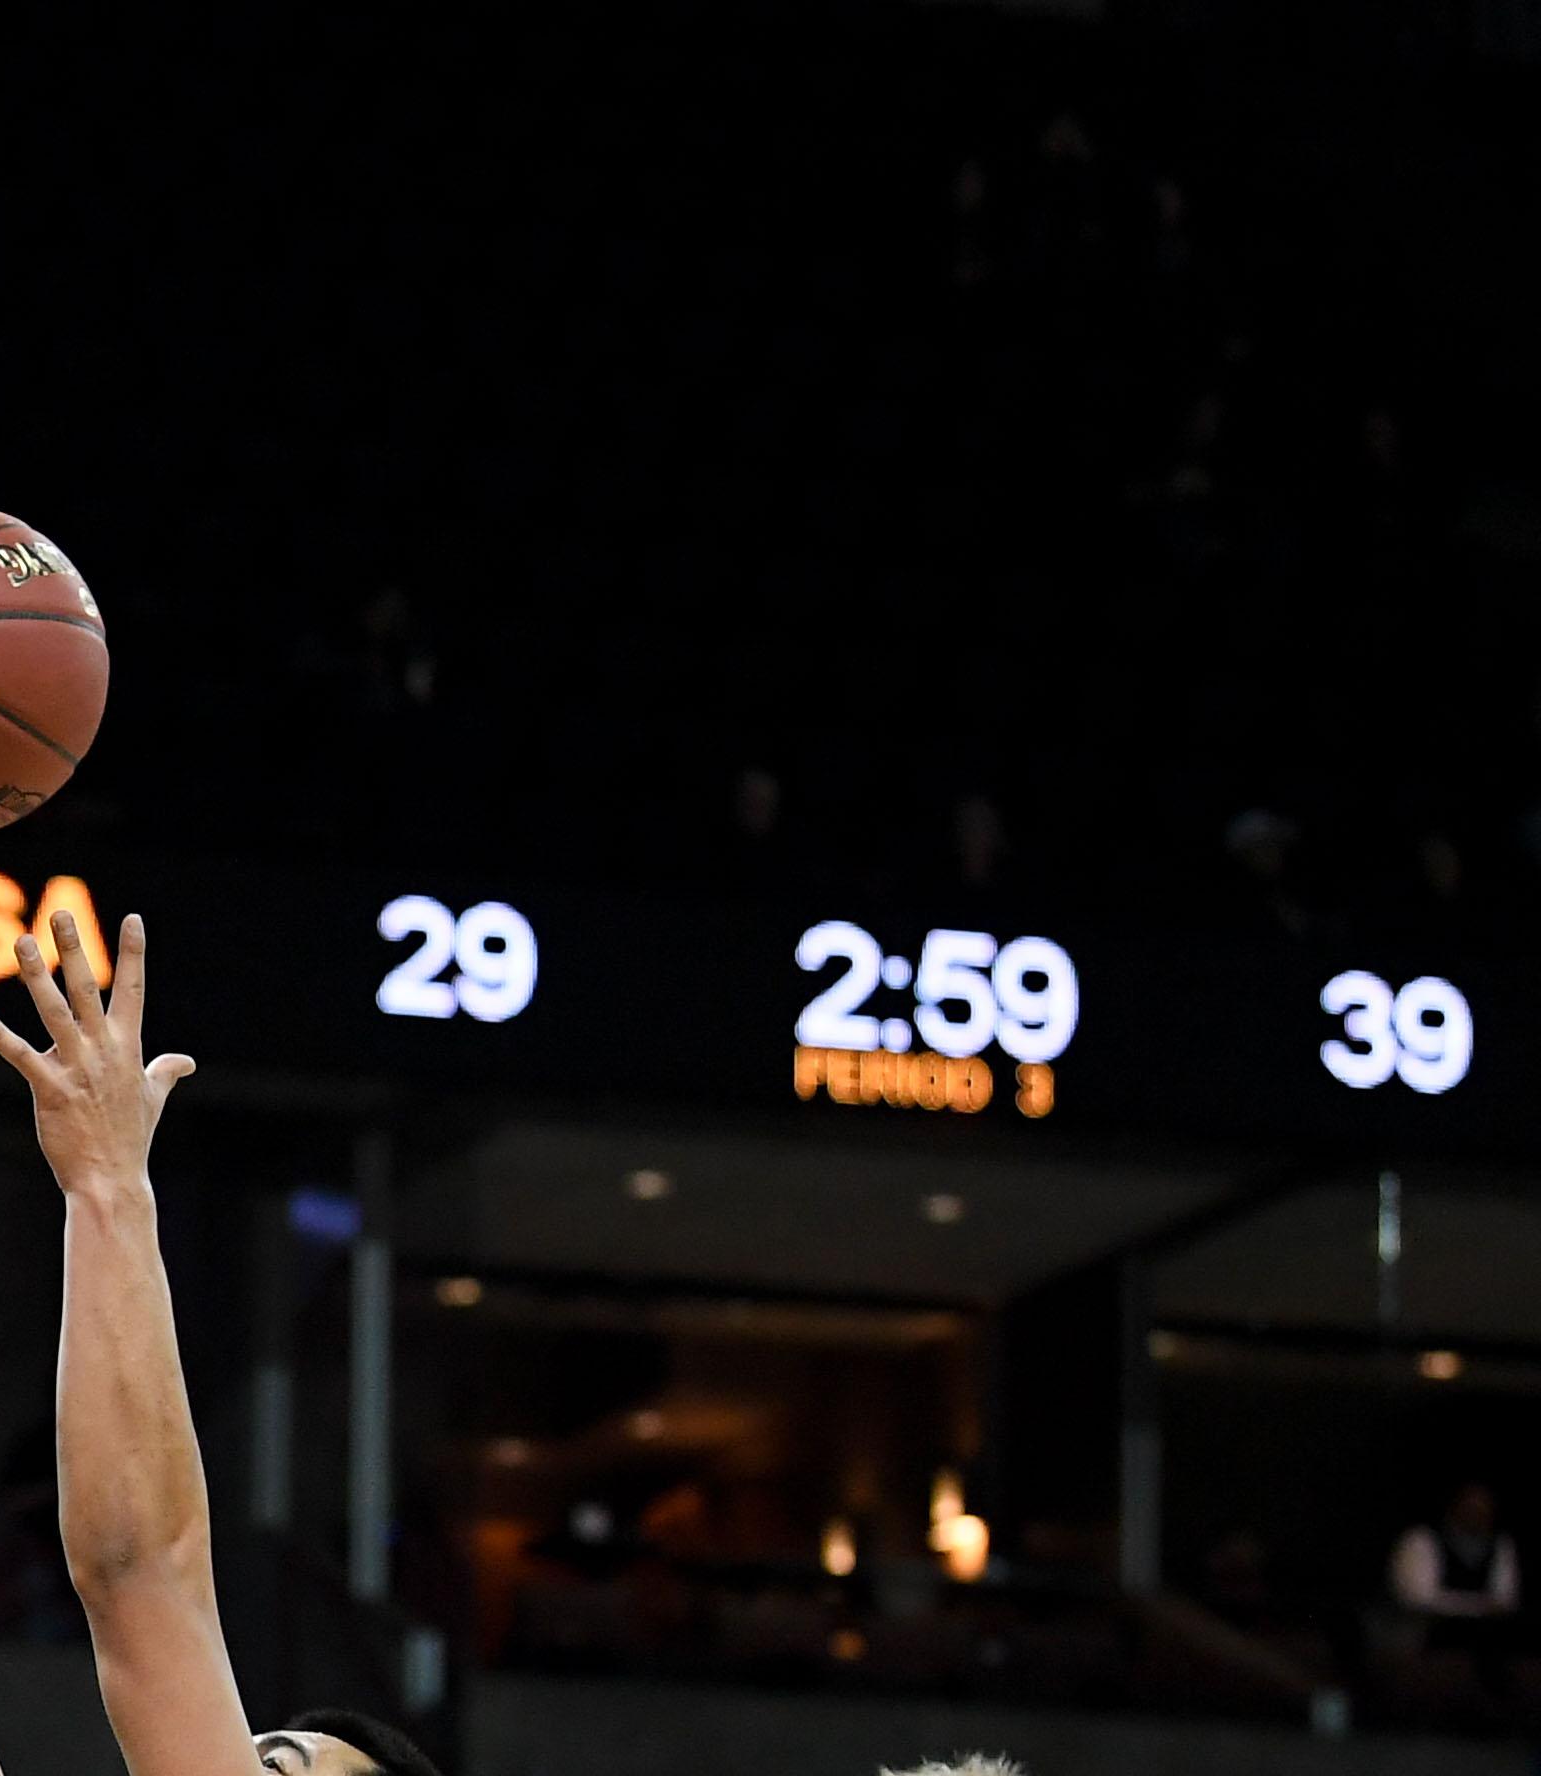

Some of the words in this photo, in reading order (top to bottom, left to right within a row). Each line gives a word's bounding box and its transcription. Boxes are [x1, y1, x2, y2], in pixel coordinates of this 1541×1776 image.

[376, 894, 538, 1022] 29
[794, 919, 1079, 1064] 2:59
[794, 1045, 993, 1115] PERIOD
[1320, 969, 1474, 1095] 39
